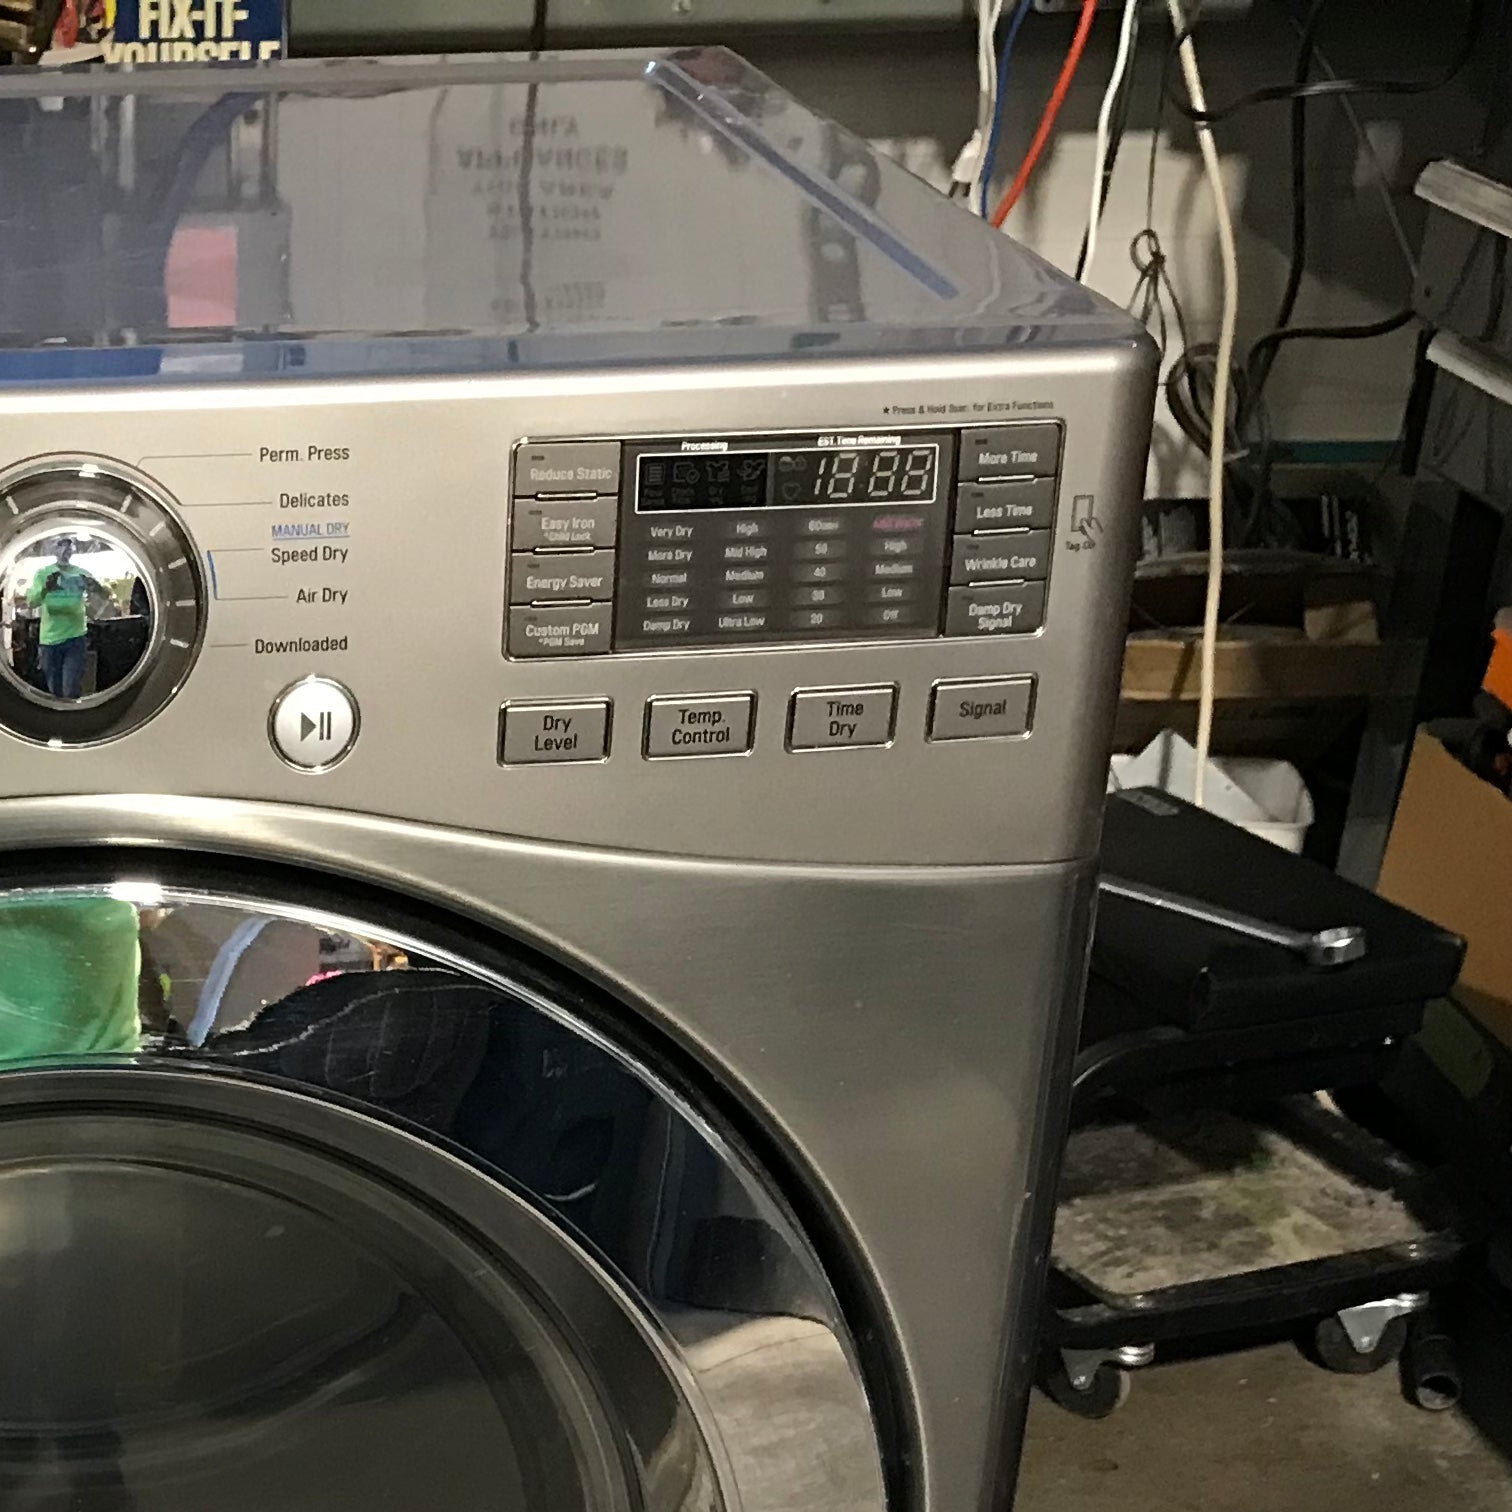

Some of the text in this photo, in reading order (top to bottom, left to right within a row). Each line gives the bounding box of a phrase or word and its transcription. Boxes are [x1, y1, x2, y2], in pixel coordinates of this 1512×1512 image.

[1012, 401, 1054, 410] Functions
[681, 441, 729, 452] Processing
[858, 434, 901, 447] Remaining
[308, 445, 350, 461] Press
[978, 451, 1038, 465] More Time
[530, 466, 613, 480] Reduce Static
[279, 492, 350, 509] Delicates
[976, 504, 1033, 519] Less Time
[271, 522, 350, 538] MANUAL DRY
[541, 517, 595, 531] Easy Iron
[736, 522, 759, 536] High
[650, 525, 694, 539] Very Dry
[271, 545, 349, 566] Speed Dry
[648, 549, 693, 562] More Dry
[745, 545, 768, 559] High
[965, 556, 1037, 572] Wrinkle Care
[526, 575, 603, 591] Energy Saver
[651, 572, 687, 584] Normal
[725, 570, 764, 581] Medium
[296, 587, 349, 605] Air Dry
[671, 595, 689, 608] Dry
[732, 593, 754, 605] Low
[969, 602, 1023, 617] Damp Dry
[525, 622, 599, 637] Custom PGM
[672, 618, 690, 631] Dry
[743, 616, 766, 628] Low
[978, 616, 1013, 631] Signal
[254, 635, 348, 655] Downloaded
[826, 701, 864, 717] Time
[959, 700, 1007, 720] Signal
[542, 714, 573, 734] Dry
[829, 720, 857, 739] Dry
[534, 734, 578, 751] Level
[671, 727, 730, 745] Control
